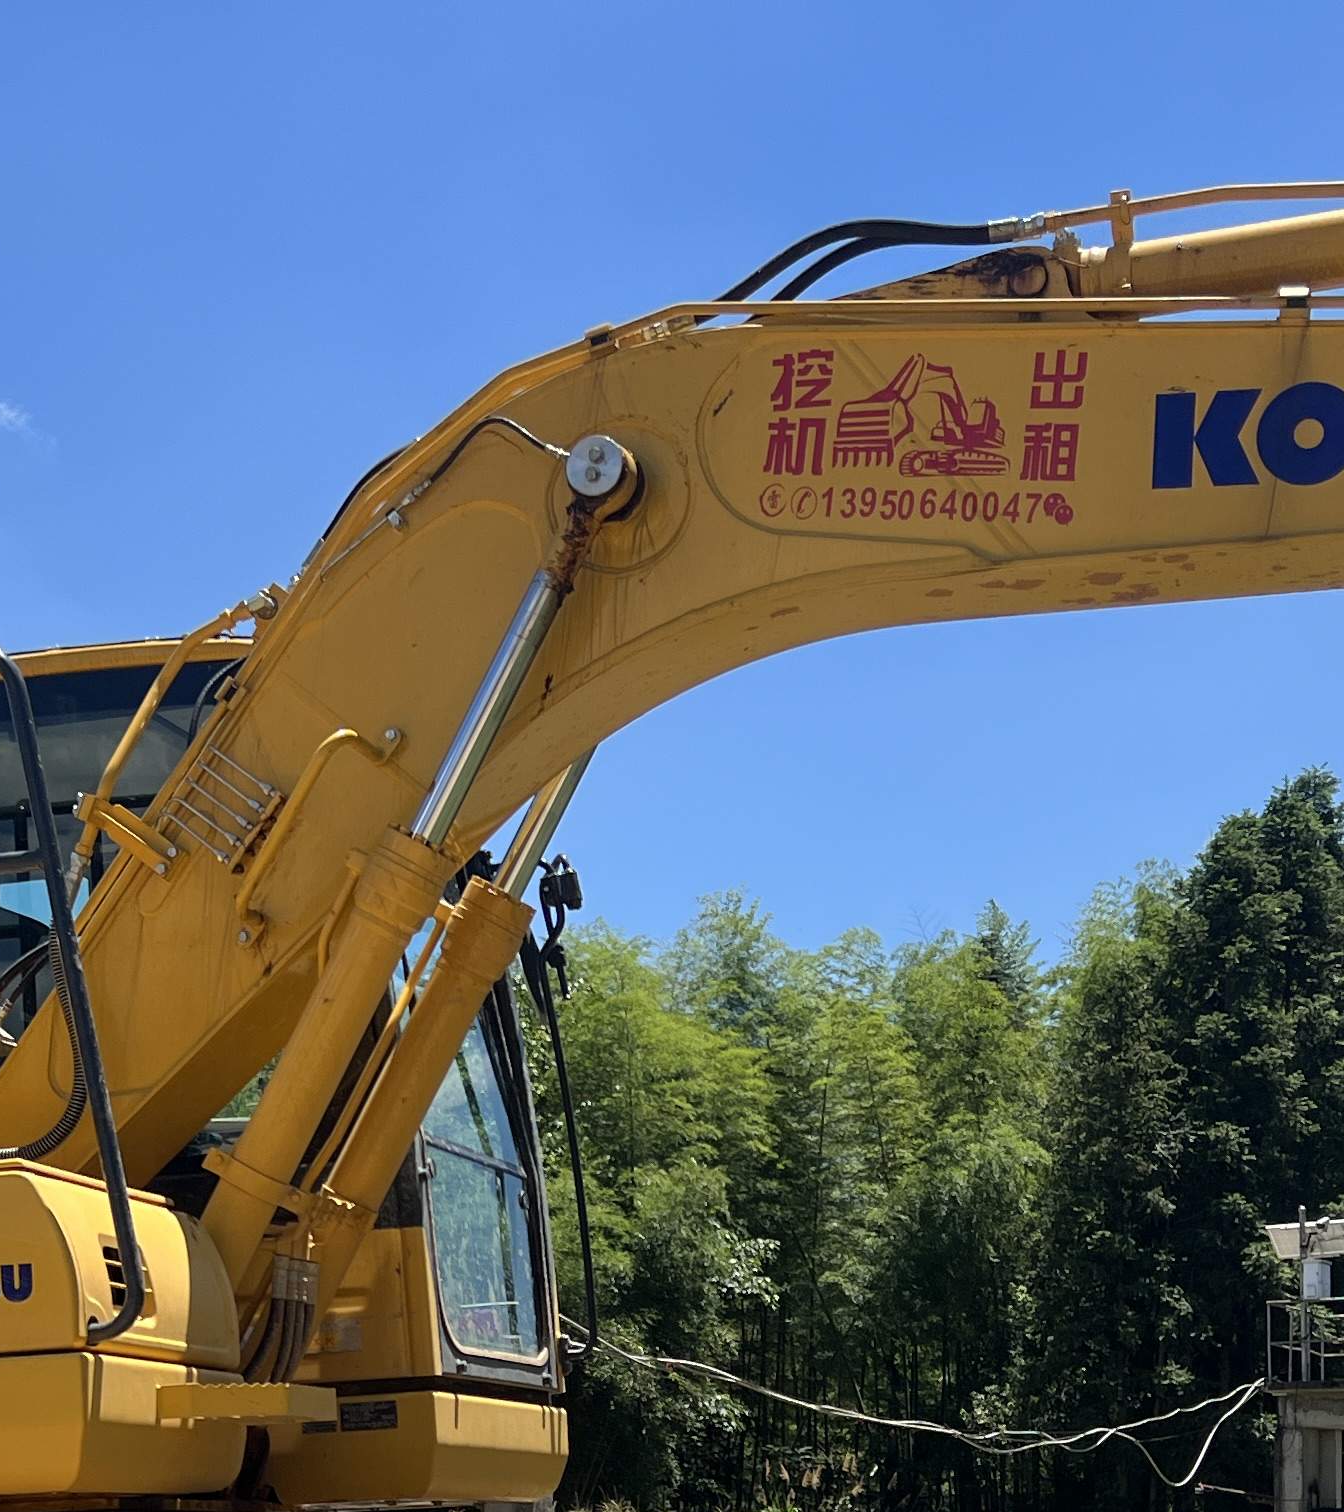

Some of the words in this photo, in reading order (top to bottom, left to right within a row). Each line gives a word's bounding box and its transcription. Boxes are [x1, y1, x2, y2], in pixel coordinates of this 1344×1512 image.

[764, 349, 834, 476] 挖机
[1020, 350, 1088, 481] 出租
[821, 487, 1040, 523] 13950640047
